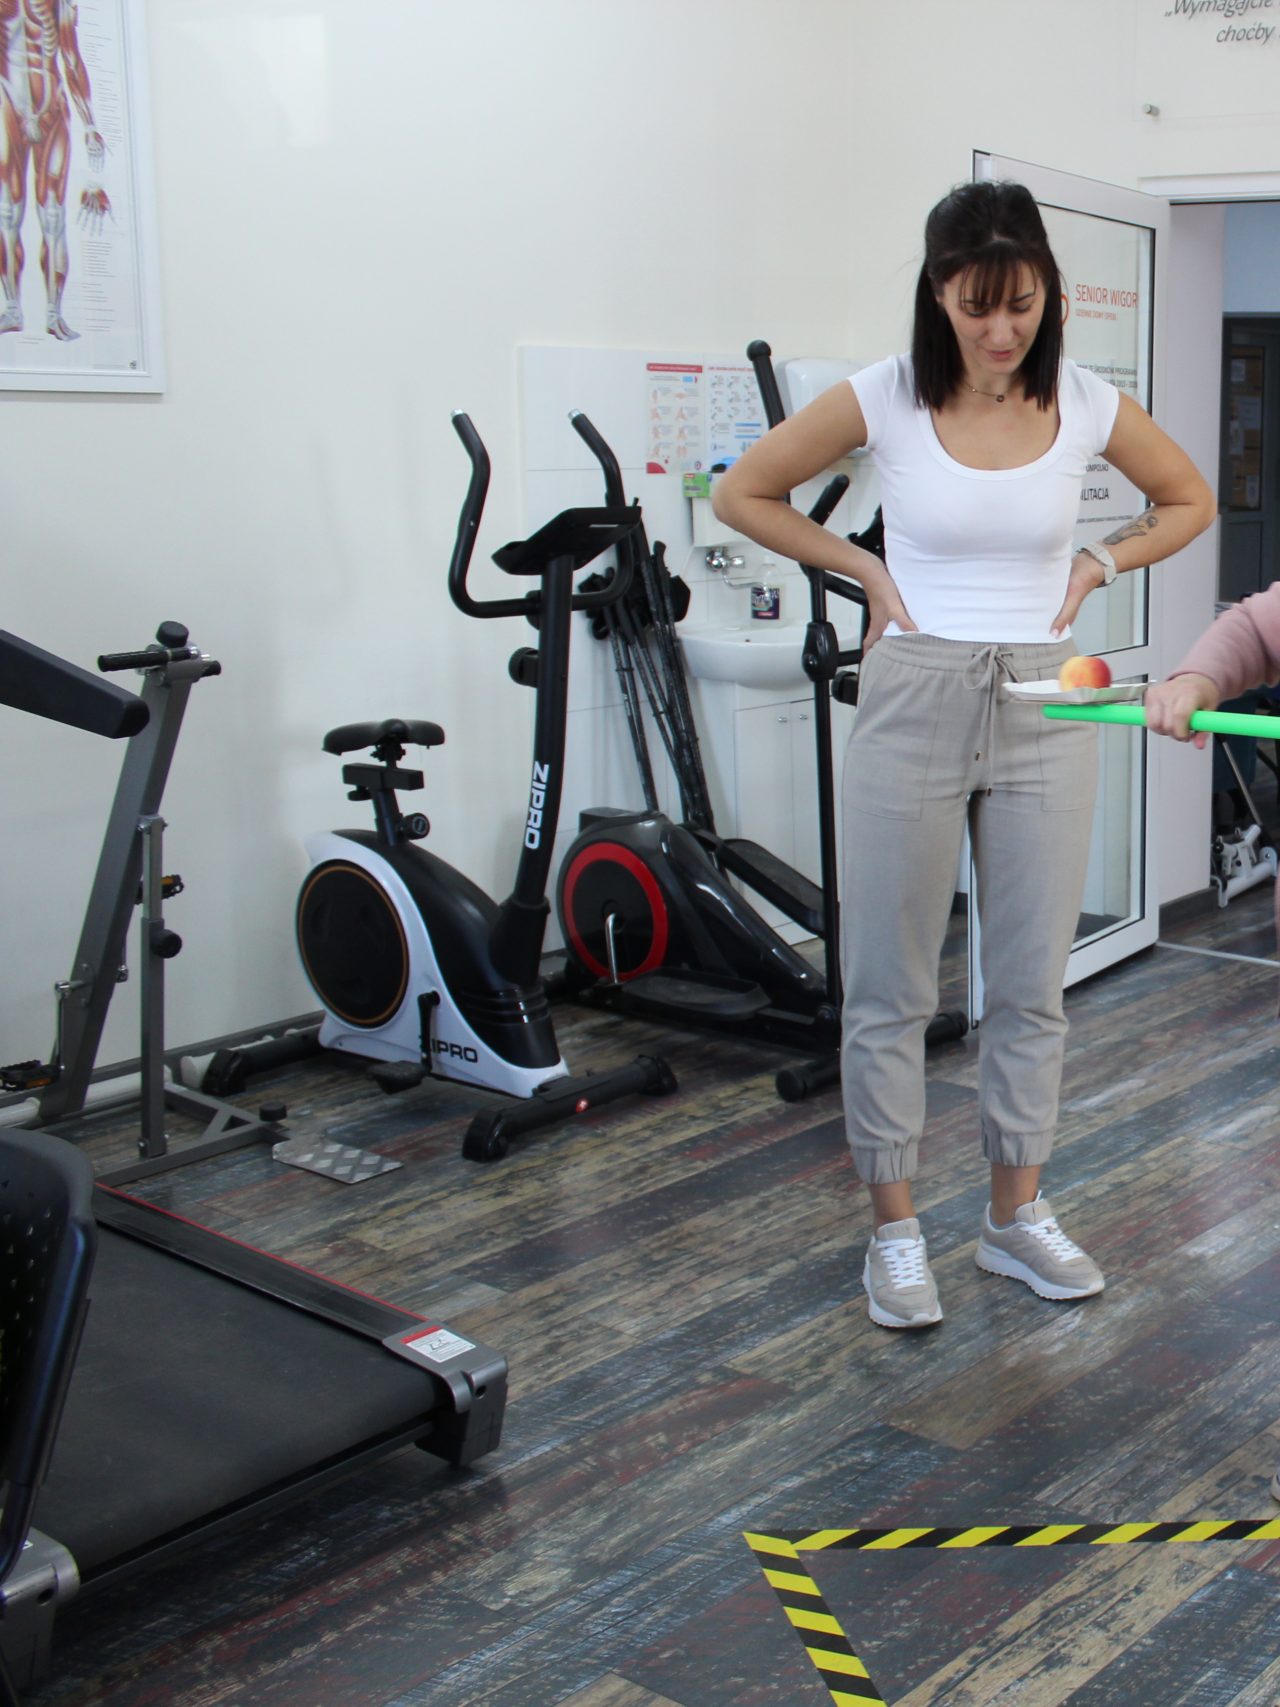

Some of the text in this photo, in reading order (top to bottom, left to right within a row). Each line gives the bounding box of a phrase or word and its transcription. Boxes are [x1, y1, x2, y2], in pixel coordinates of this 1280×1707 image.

[1216, 21, 1275, 45] choćby
[1075, 284, 1137, 308] SENIOR WIGOR
[1080, 487, 1109, 501] ILITACJA
[525, 760, 550, 850] ZIPRO
[430, 1038, 478, 1064] IPRO
